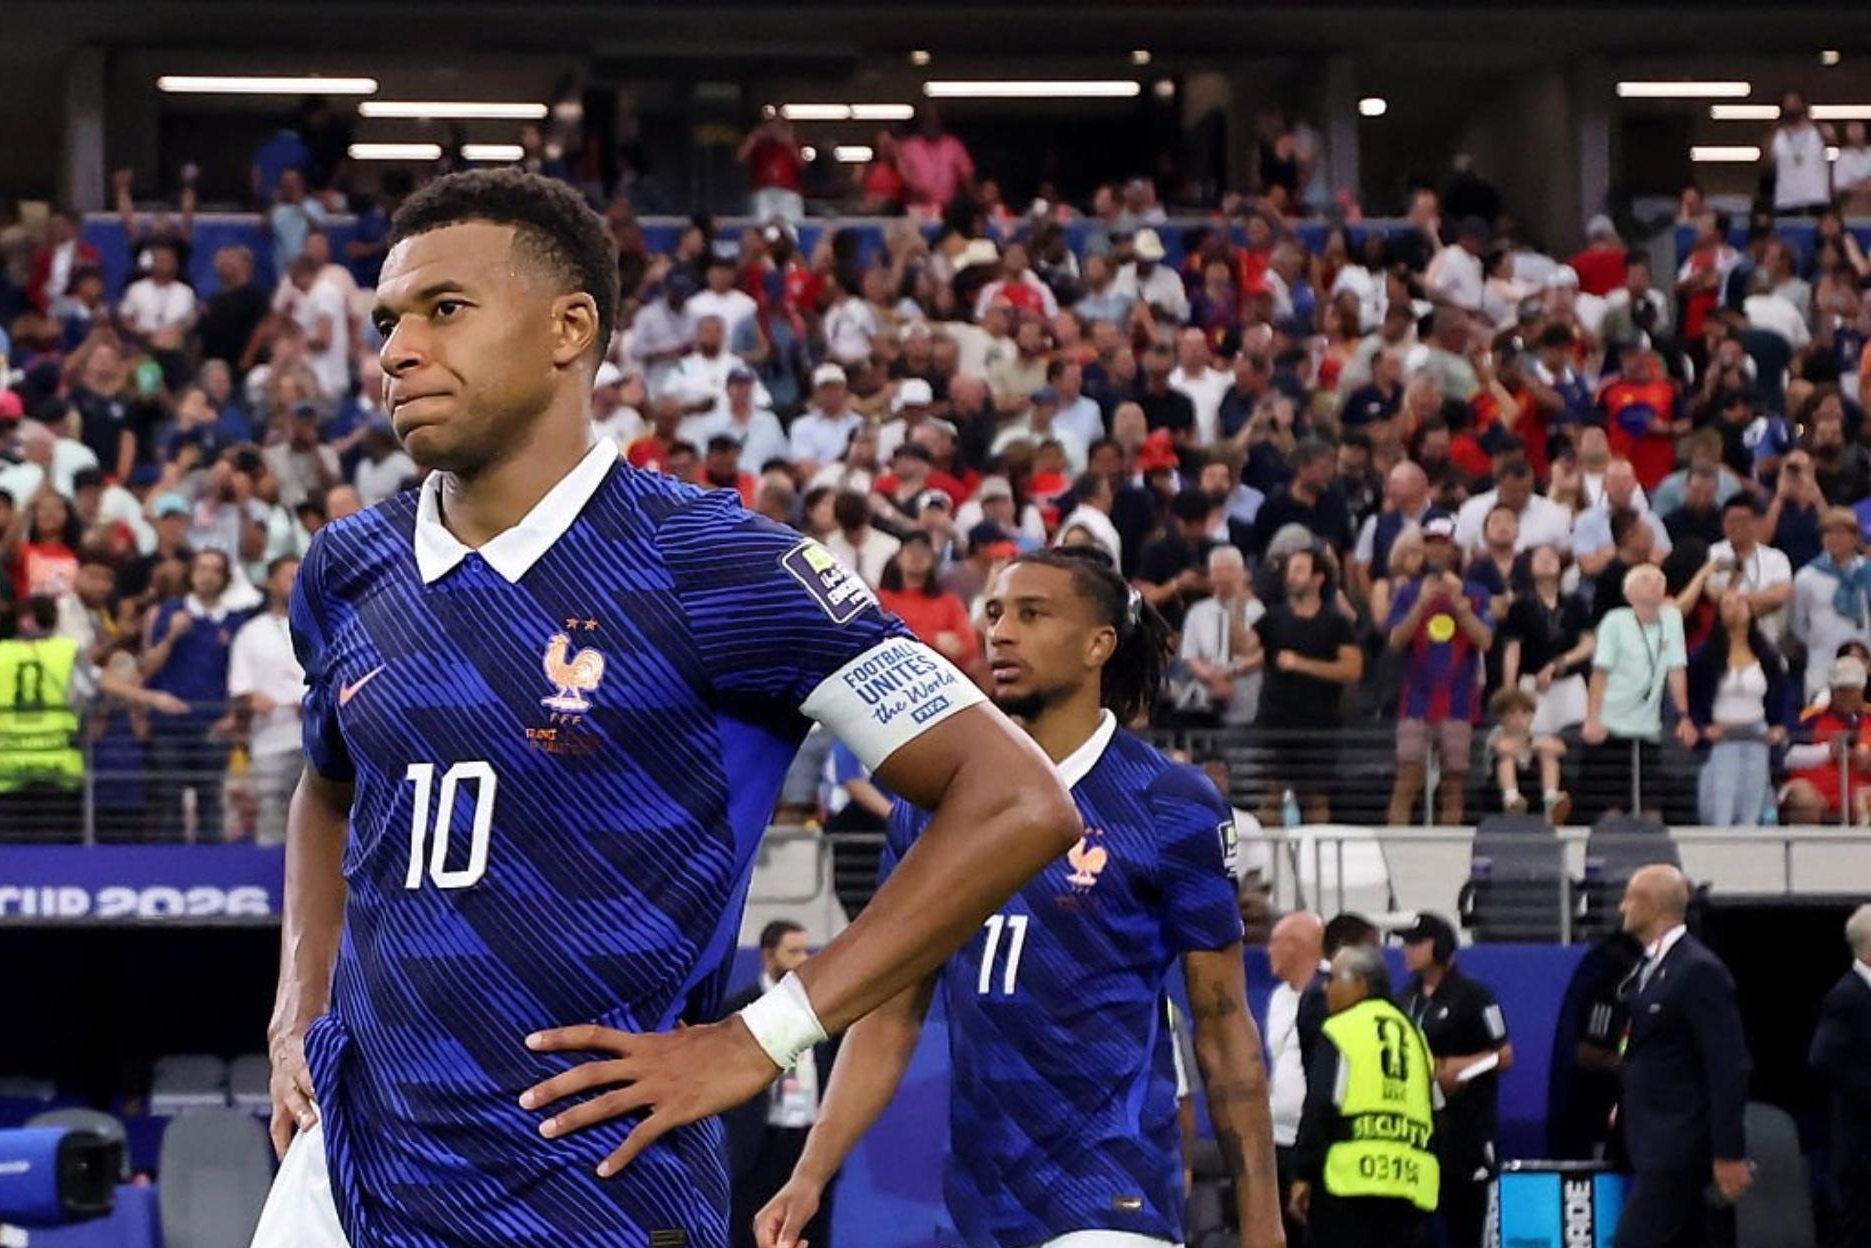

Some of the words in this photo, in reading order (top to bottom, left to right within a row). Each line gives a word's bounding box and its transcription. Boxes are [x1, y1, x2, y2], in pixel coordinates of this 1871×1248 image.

[843, 642, 920, 689] FOOTBALL
[856, 654, 939, 705] UNITES
[872, 701, 908, 725] the
[902, 668, 957, 704] World
[405, 760, 498, 889] 10
[94, 885, 271, 918] 2026
[978, 914, 1029, 995] 11
